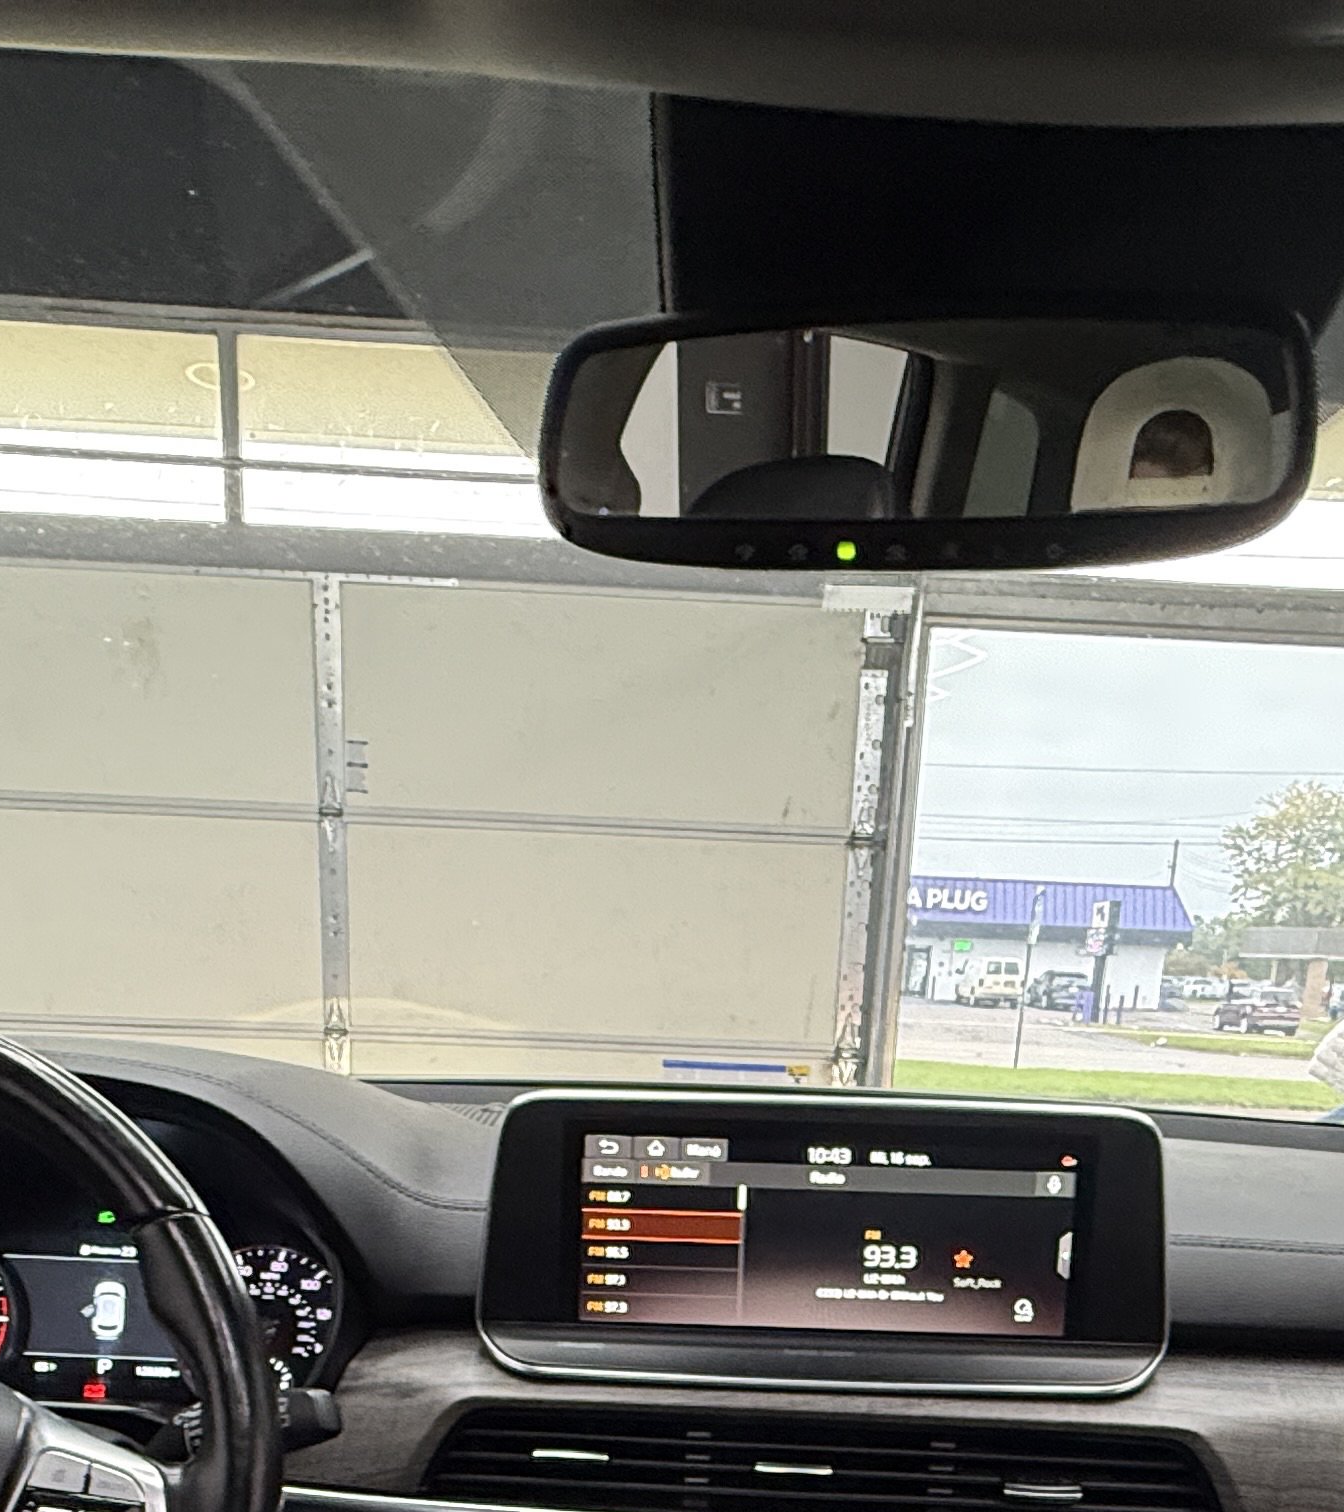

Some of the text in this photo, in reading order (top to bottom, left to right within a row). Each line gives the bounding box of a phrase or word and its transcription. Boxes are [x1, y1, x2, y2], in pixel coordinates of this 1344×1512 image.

[926, 888, 988, 911] PLUG
[863, 1245, 918, 1269] 93.3
[96, 1358, 113, 1375] P
